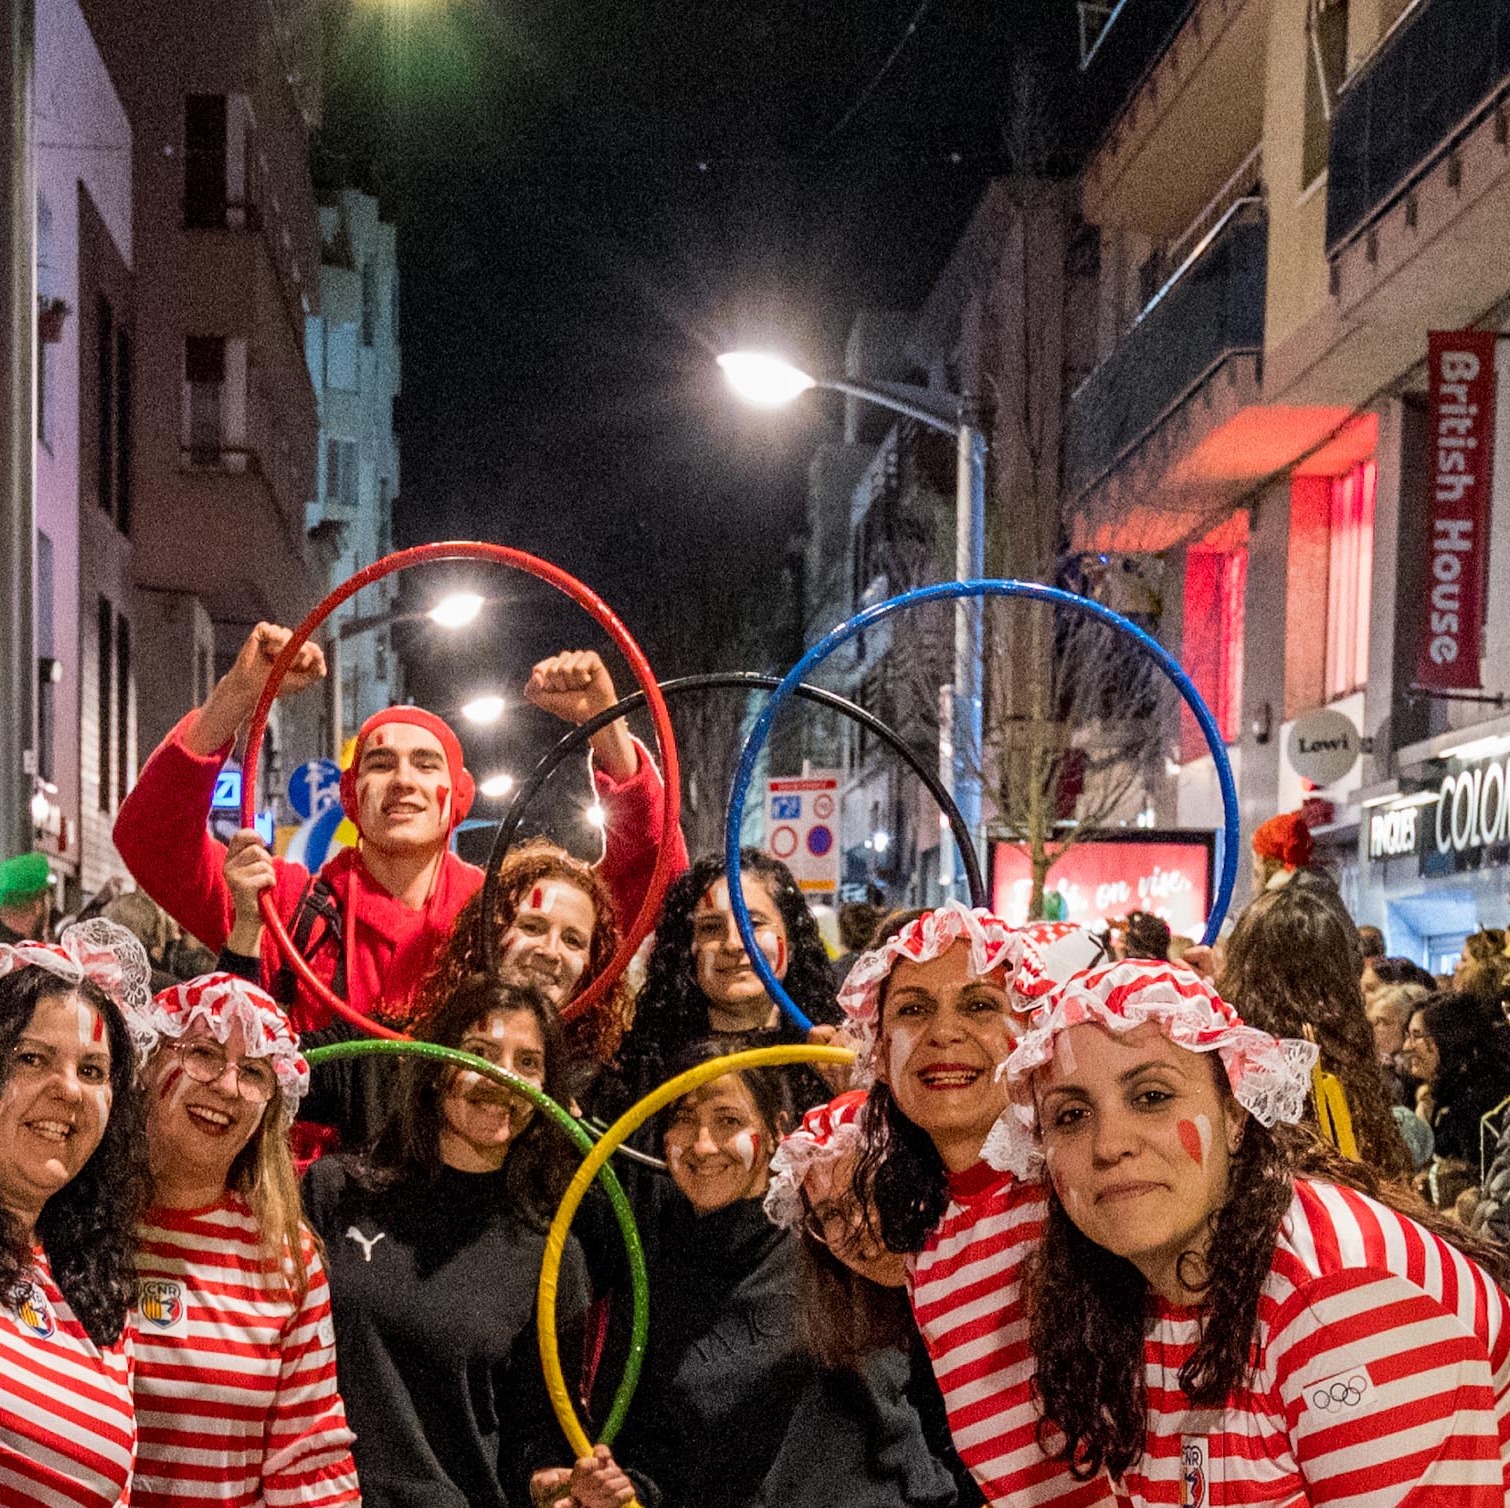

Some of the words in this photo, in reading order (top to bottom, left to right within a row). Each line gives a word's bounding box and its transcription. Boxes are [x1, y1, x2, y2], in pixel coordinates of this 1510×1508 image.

[1436, 350, 1480, 501] British
[1428, 518, 1475, 666] House
[1298, 733, 1350, 754] Lowi
[144, 1281, 179, 1298] CNR
